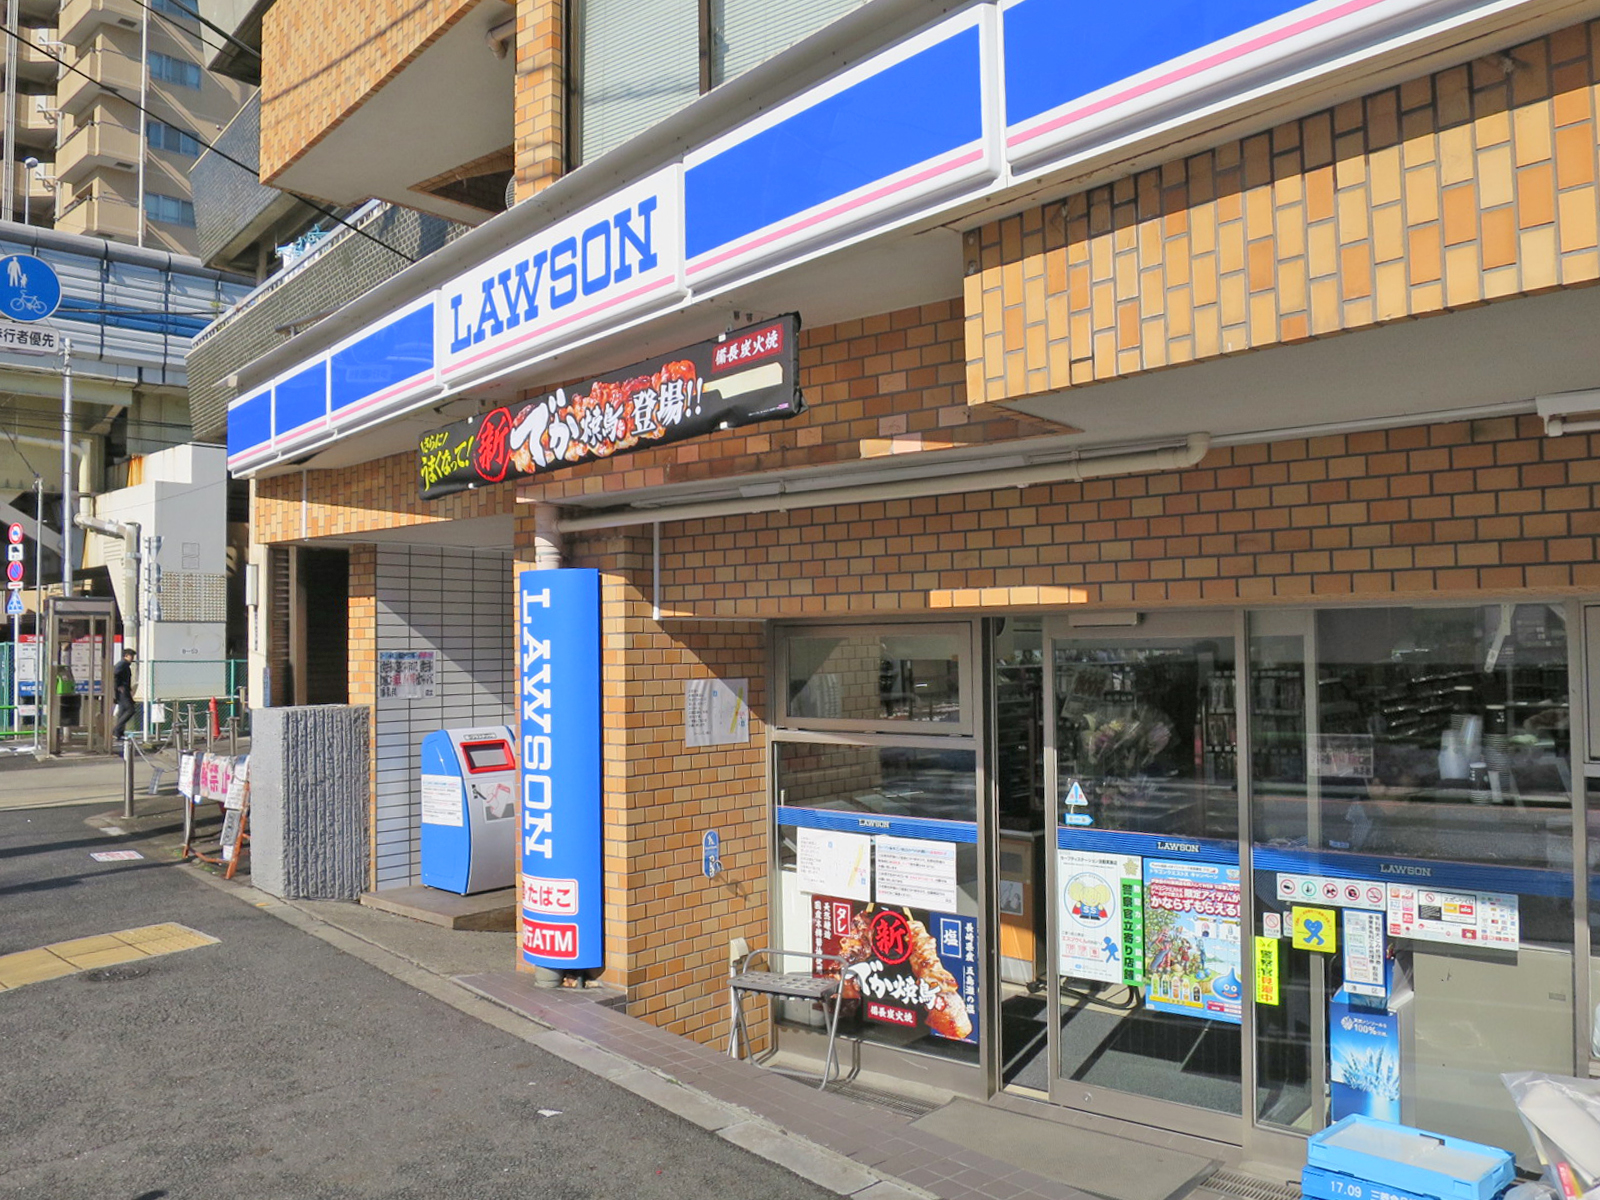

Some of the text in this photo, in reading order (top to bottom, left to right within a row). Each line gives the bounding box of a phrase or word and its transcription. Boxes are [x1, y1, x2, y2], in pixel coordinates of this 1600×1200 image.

[450, 195, 658, 355] LAWSON
[714, 329, 779, 366] 備長炭火焼
[477, 415, 509, 471] 新
[523, 588, 552, 859] LAWSON
[857, 818, 890, 829] LAWSON
[1156, 841, 1200, 853] LAWSON
[1380, 863, 1432, 877] LAWSON
[836, 908, 847, 932] タレ
[1083, 906, 1097, 914] SS
[875, 919, 906, 954] 新
[944, 929, 959, 946] 塩
[1331, 1181, 1362, 1198] 17.09
